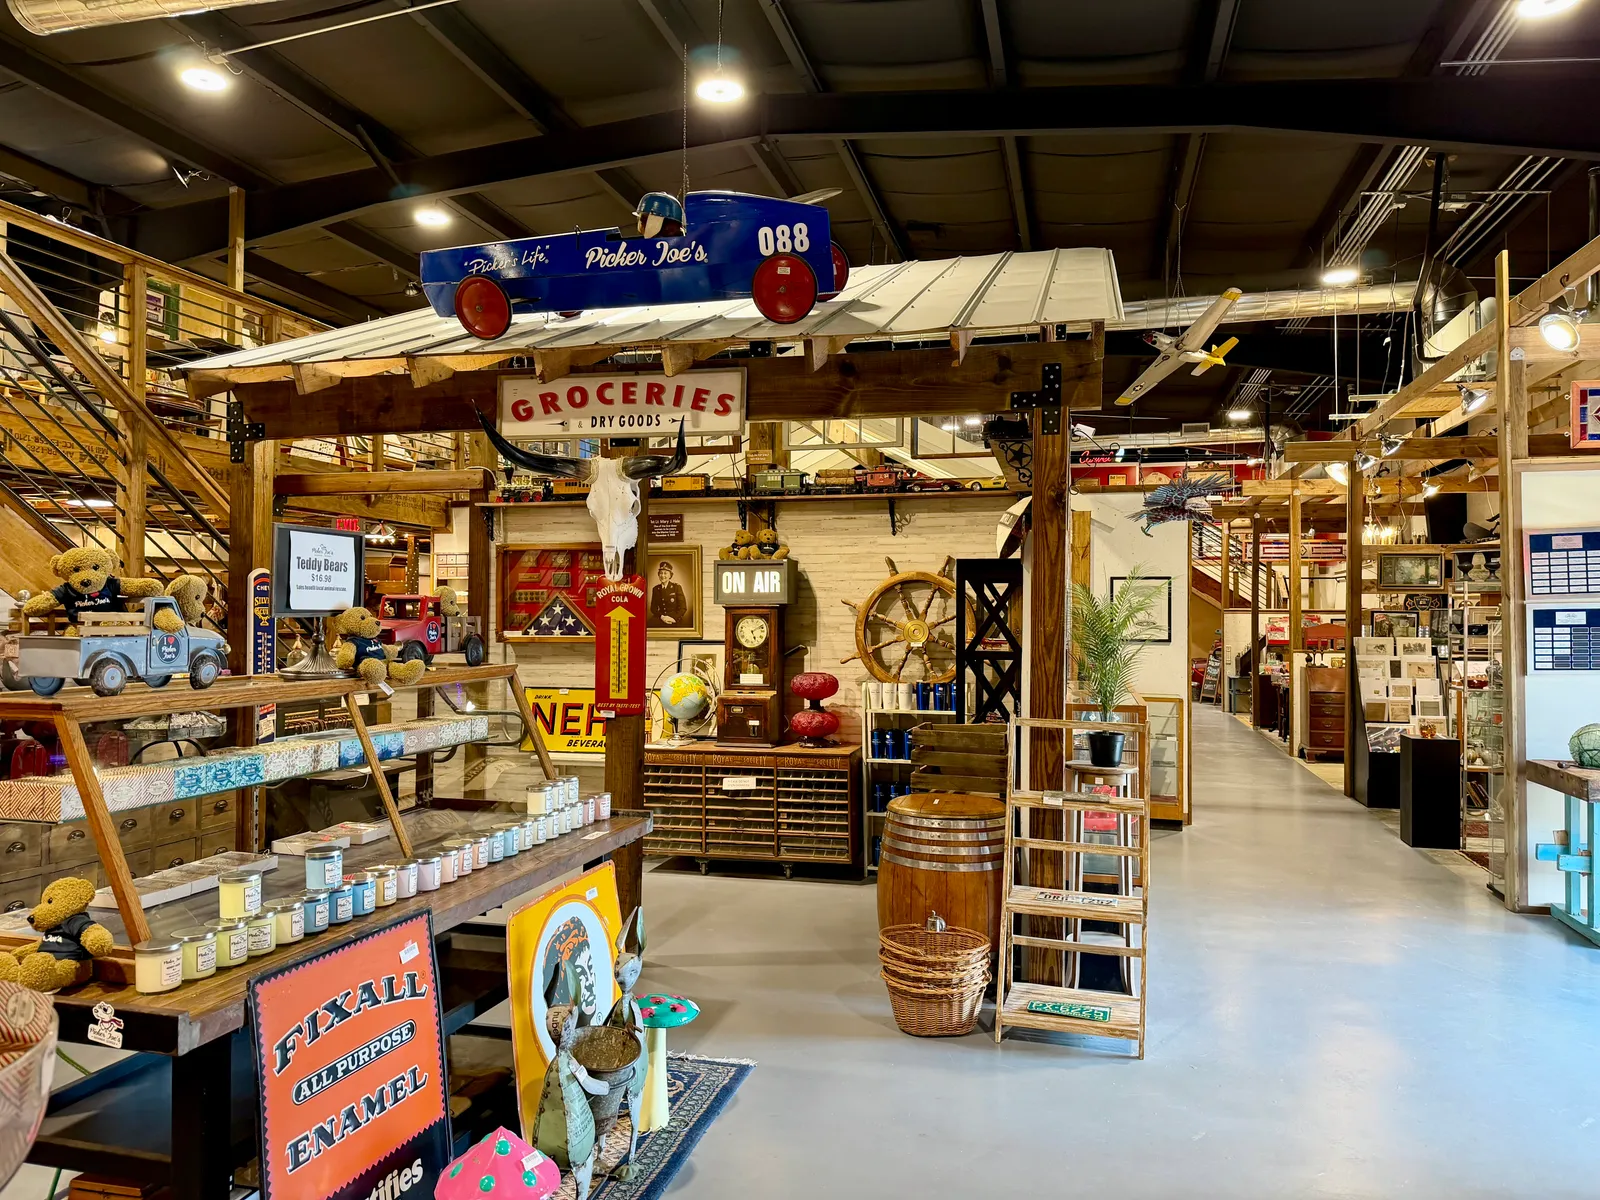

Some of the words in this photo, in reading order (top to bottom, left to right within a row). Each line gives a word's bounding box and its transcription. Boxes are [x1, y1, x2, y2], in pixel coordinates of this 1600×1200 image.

[758, 223, 810, 256] 088
[585, 246, 647, 269] Picker
[651, 240, 709, 267] Joe's
[511, 381, 735, 422] GROCERIES
[591, 416, 614, 429] DRY
[619, 414, 661, 428] GOODS
[336, 518, 357, 531] EXIT
[296, 556, 322, 572] Teddy
[324, 558, 348, 573] Bears
[311, 573, 332, 583] $16.98
[722, 571, 746, 593] ON
[753, 571, 781, 593] AIR
[596, 583, 619, 600] ROYAL
[619, 583, 644, 599] CROWN
[611, 595, 629, 603] COLA
[530, 702, 606, 736] NEH
[566, 739, 606, 748] BEVERA
[273, 970, 428, 1075] FIXALL
[297, 1069, 333, 1101] ALL
[335, 1023, 412, 1077] PURPOSE
[285, 1064, 428, 1174] ENAMEL
[364, 1157, 424, 1200] tifies
